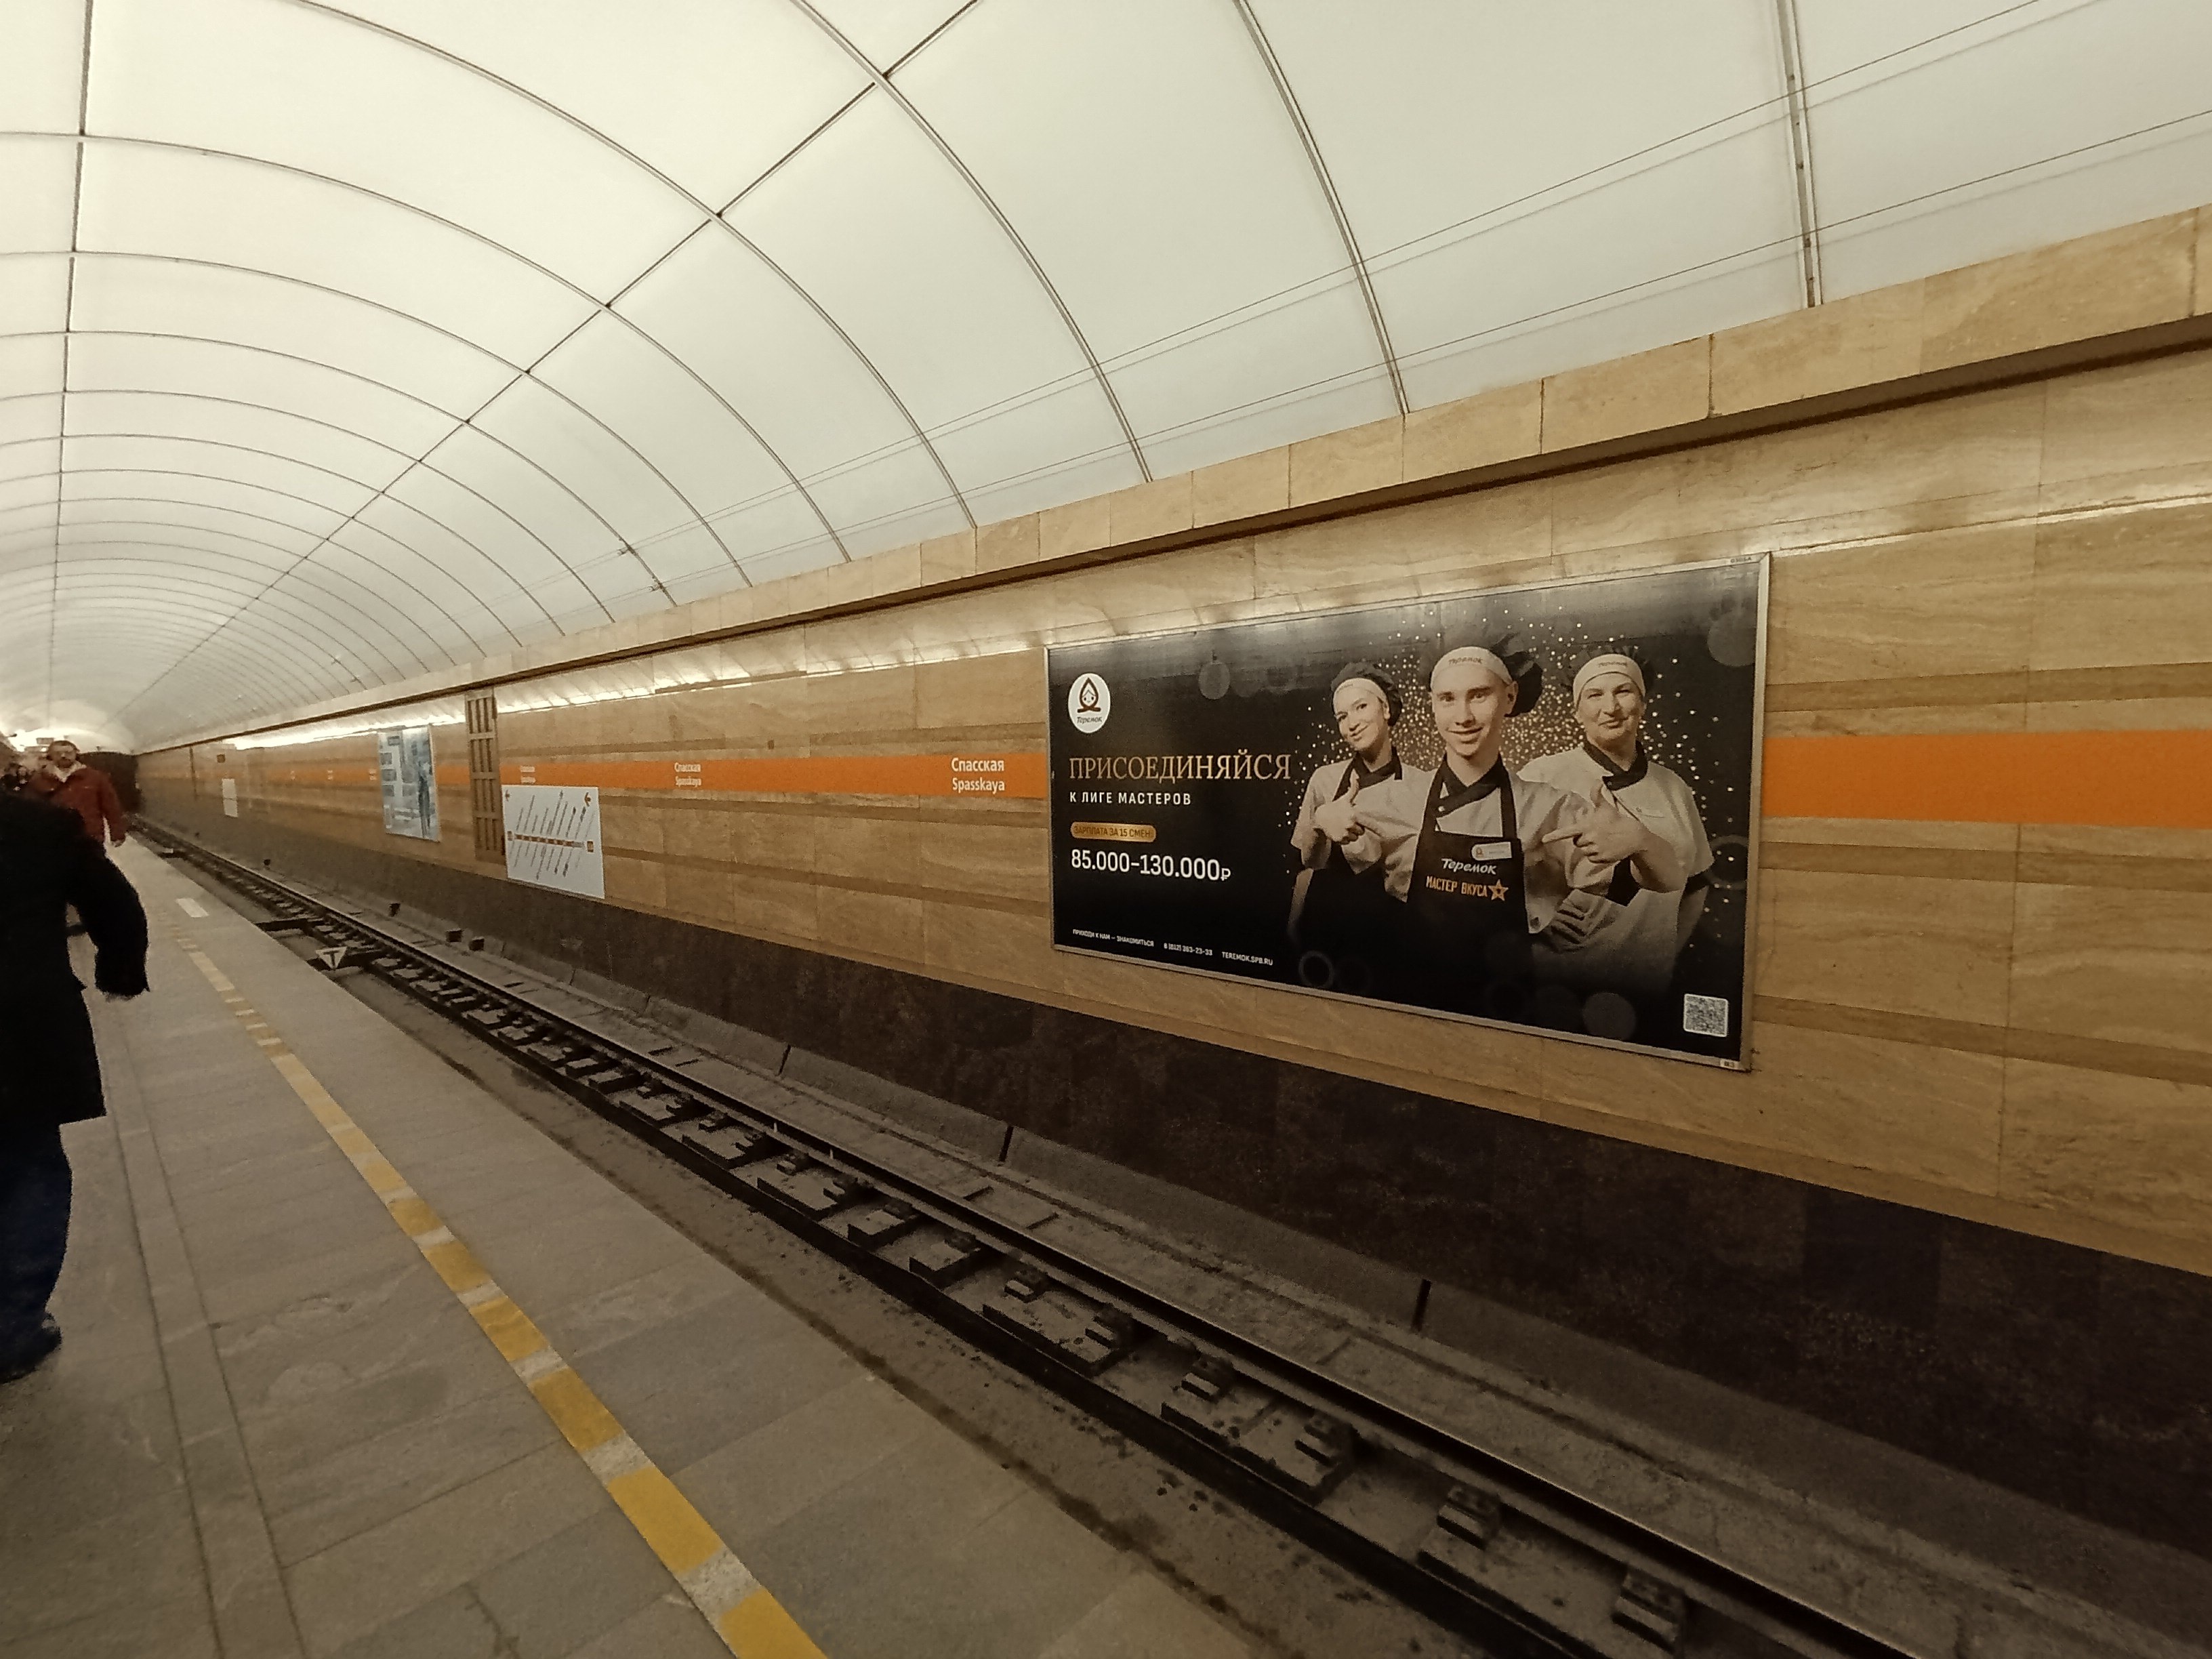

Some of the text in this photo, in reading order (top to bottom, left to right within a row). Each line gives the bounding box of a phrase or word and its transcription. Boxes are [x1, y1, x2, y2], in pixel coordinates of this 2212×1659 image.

[951, 757, 1004, 772] Спасская
[1069, 748, 1291, 784] ПРИСОЕДИНЯЙСЯ
[952, 777, 1005, 794] Spasskaya
[1069, 792, 1191, 805] К ЛИГЕ МАСТЕРОВ
[1073, 826, 1108, 836] ЗАРПЛАТА
[1109, 828, 1119, 836] ЗА
[1120, 828, 1128, 837] 15
[1441, 858, 1497, 875] Теремок
[1426, 876, 1488, 897] МАСТЕР ВКУСА
[1116, 935, 1154, 947] ЗНАКОМИТЬСЯ
[1222, 951, 1273, 966] TEREMOK.SPB.RU
